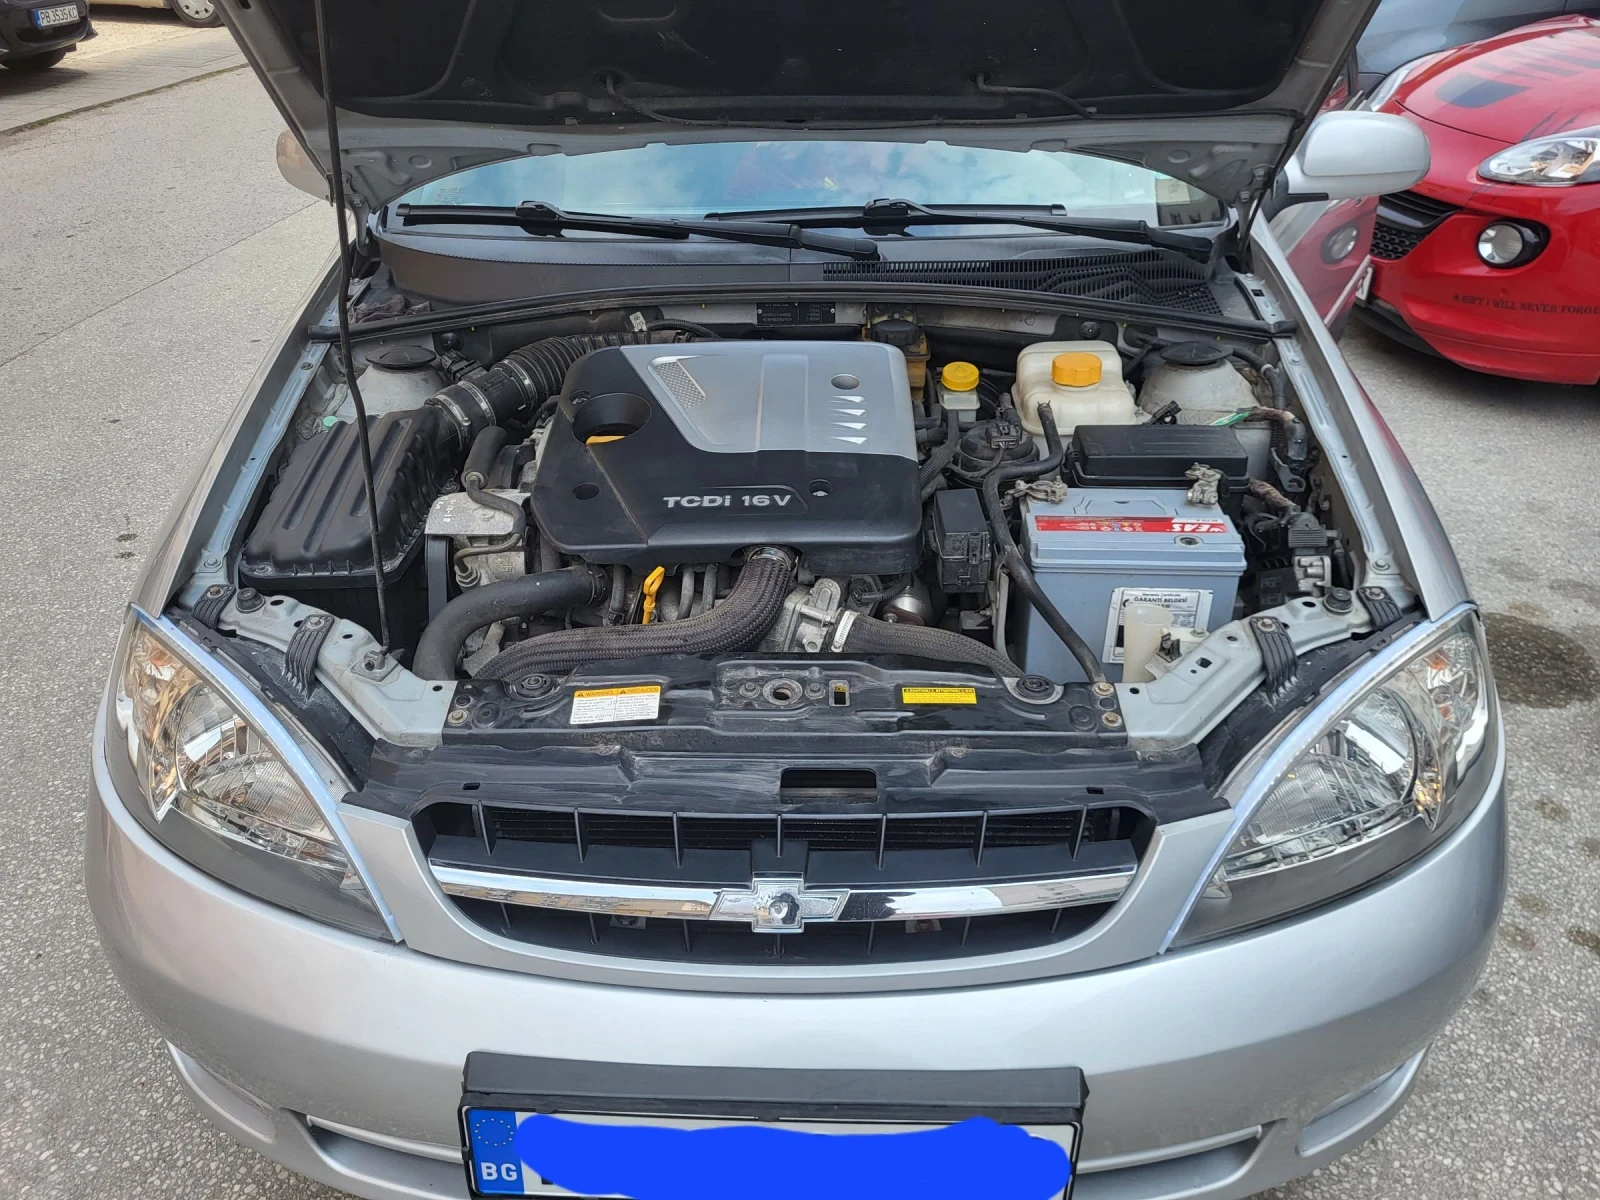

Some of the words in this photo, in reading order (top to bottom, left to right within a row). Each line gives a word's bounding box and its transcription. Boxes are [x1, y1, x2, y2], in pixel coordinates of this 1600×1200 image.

[40, 11, 51, 23] PB
[52, 9, 68, 22] 3535
[68, 7, 78, 20] KC
[1462, 295, 1485, 306] GIFT
[1492, 300, 1517, 310] WILL
[1519, 303, 1558, 313] NEVER
[663, 495, 731, 508] TCDi
[741, 495, 792, 506] 16V
[481, 1161, 518, 1182] BG
